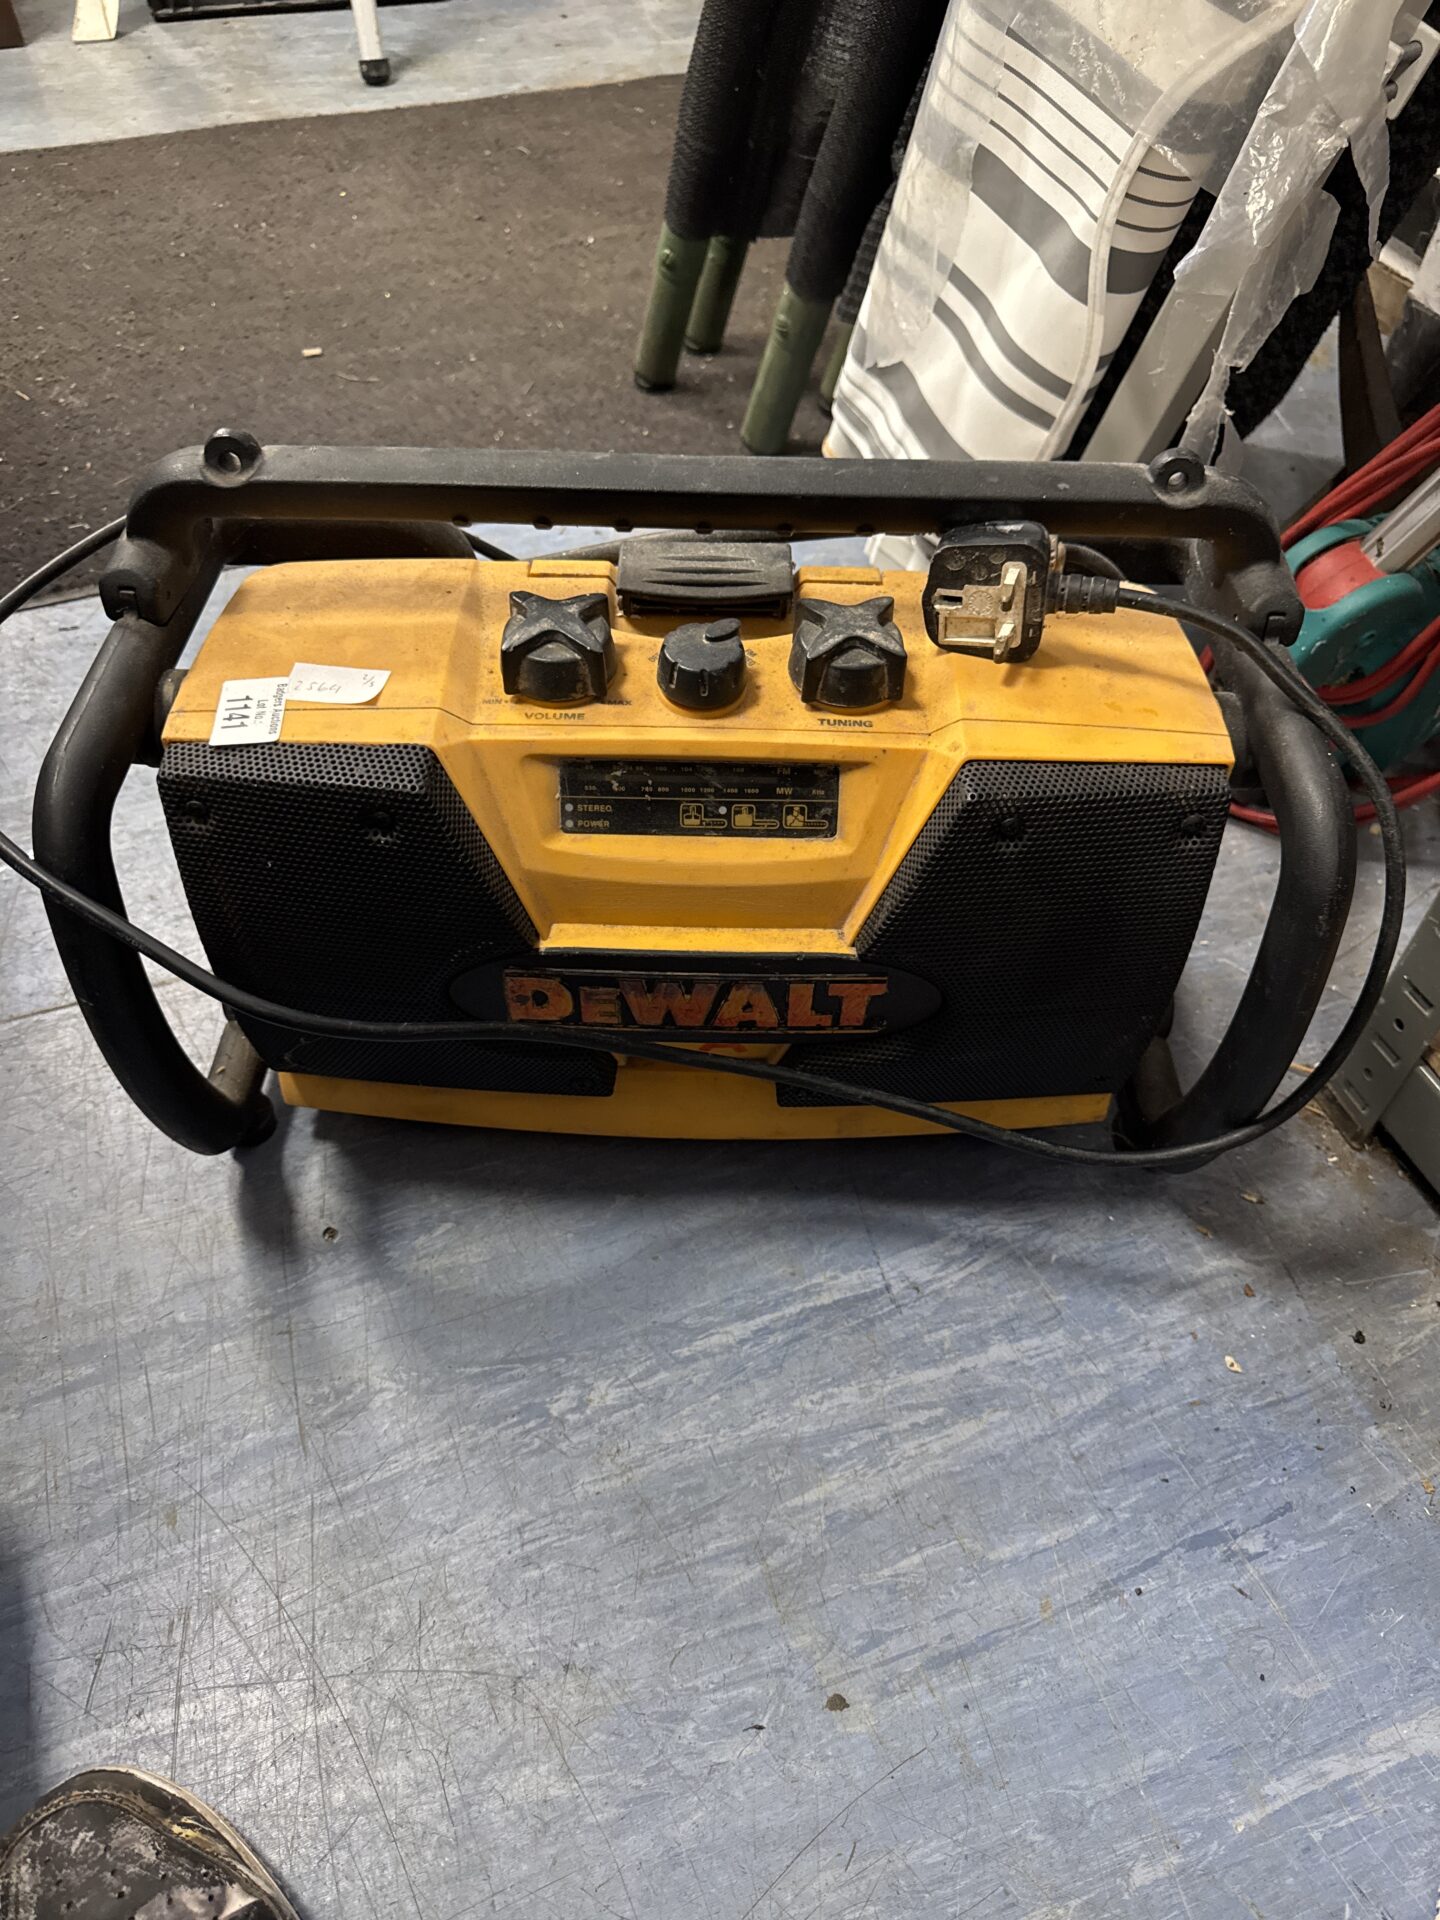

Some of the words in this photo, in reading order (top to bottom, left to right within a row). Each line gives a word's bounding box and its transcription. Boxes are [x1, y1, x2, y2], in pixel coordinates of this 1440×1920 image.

[272, 683, 289, 707] Badgers
[255, 699, 269, 709] Lot
[220, 695, 253, 729] 1141
[524, 712, 586, 721] VOLUME
[268, 708, 284, 736] Auctions
[817, 718, 874, 728] TUNING
[776, 767, 791, 775] FM
[776, 787, 793, 795] MW
[577, 804, 613, 813] STEREO
[577, 819, 610, 828] POWER
